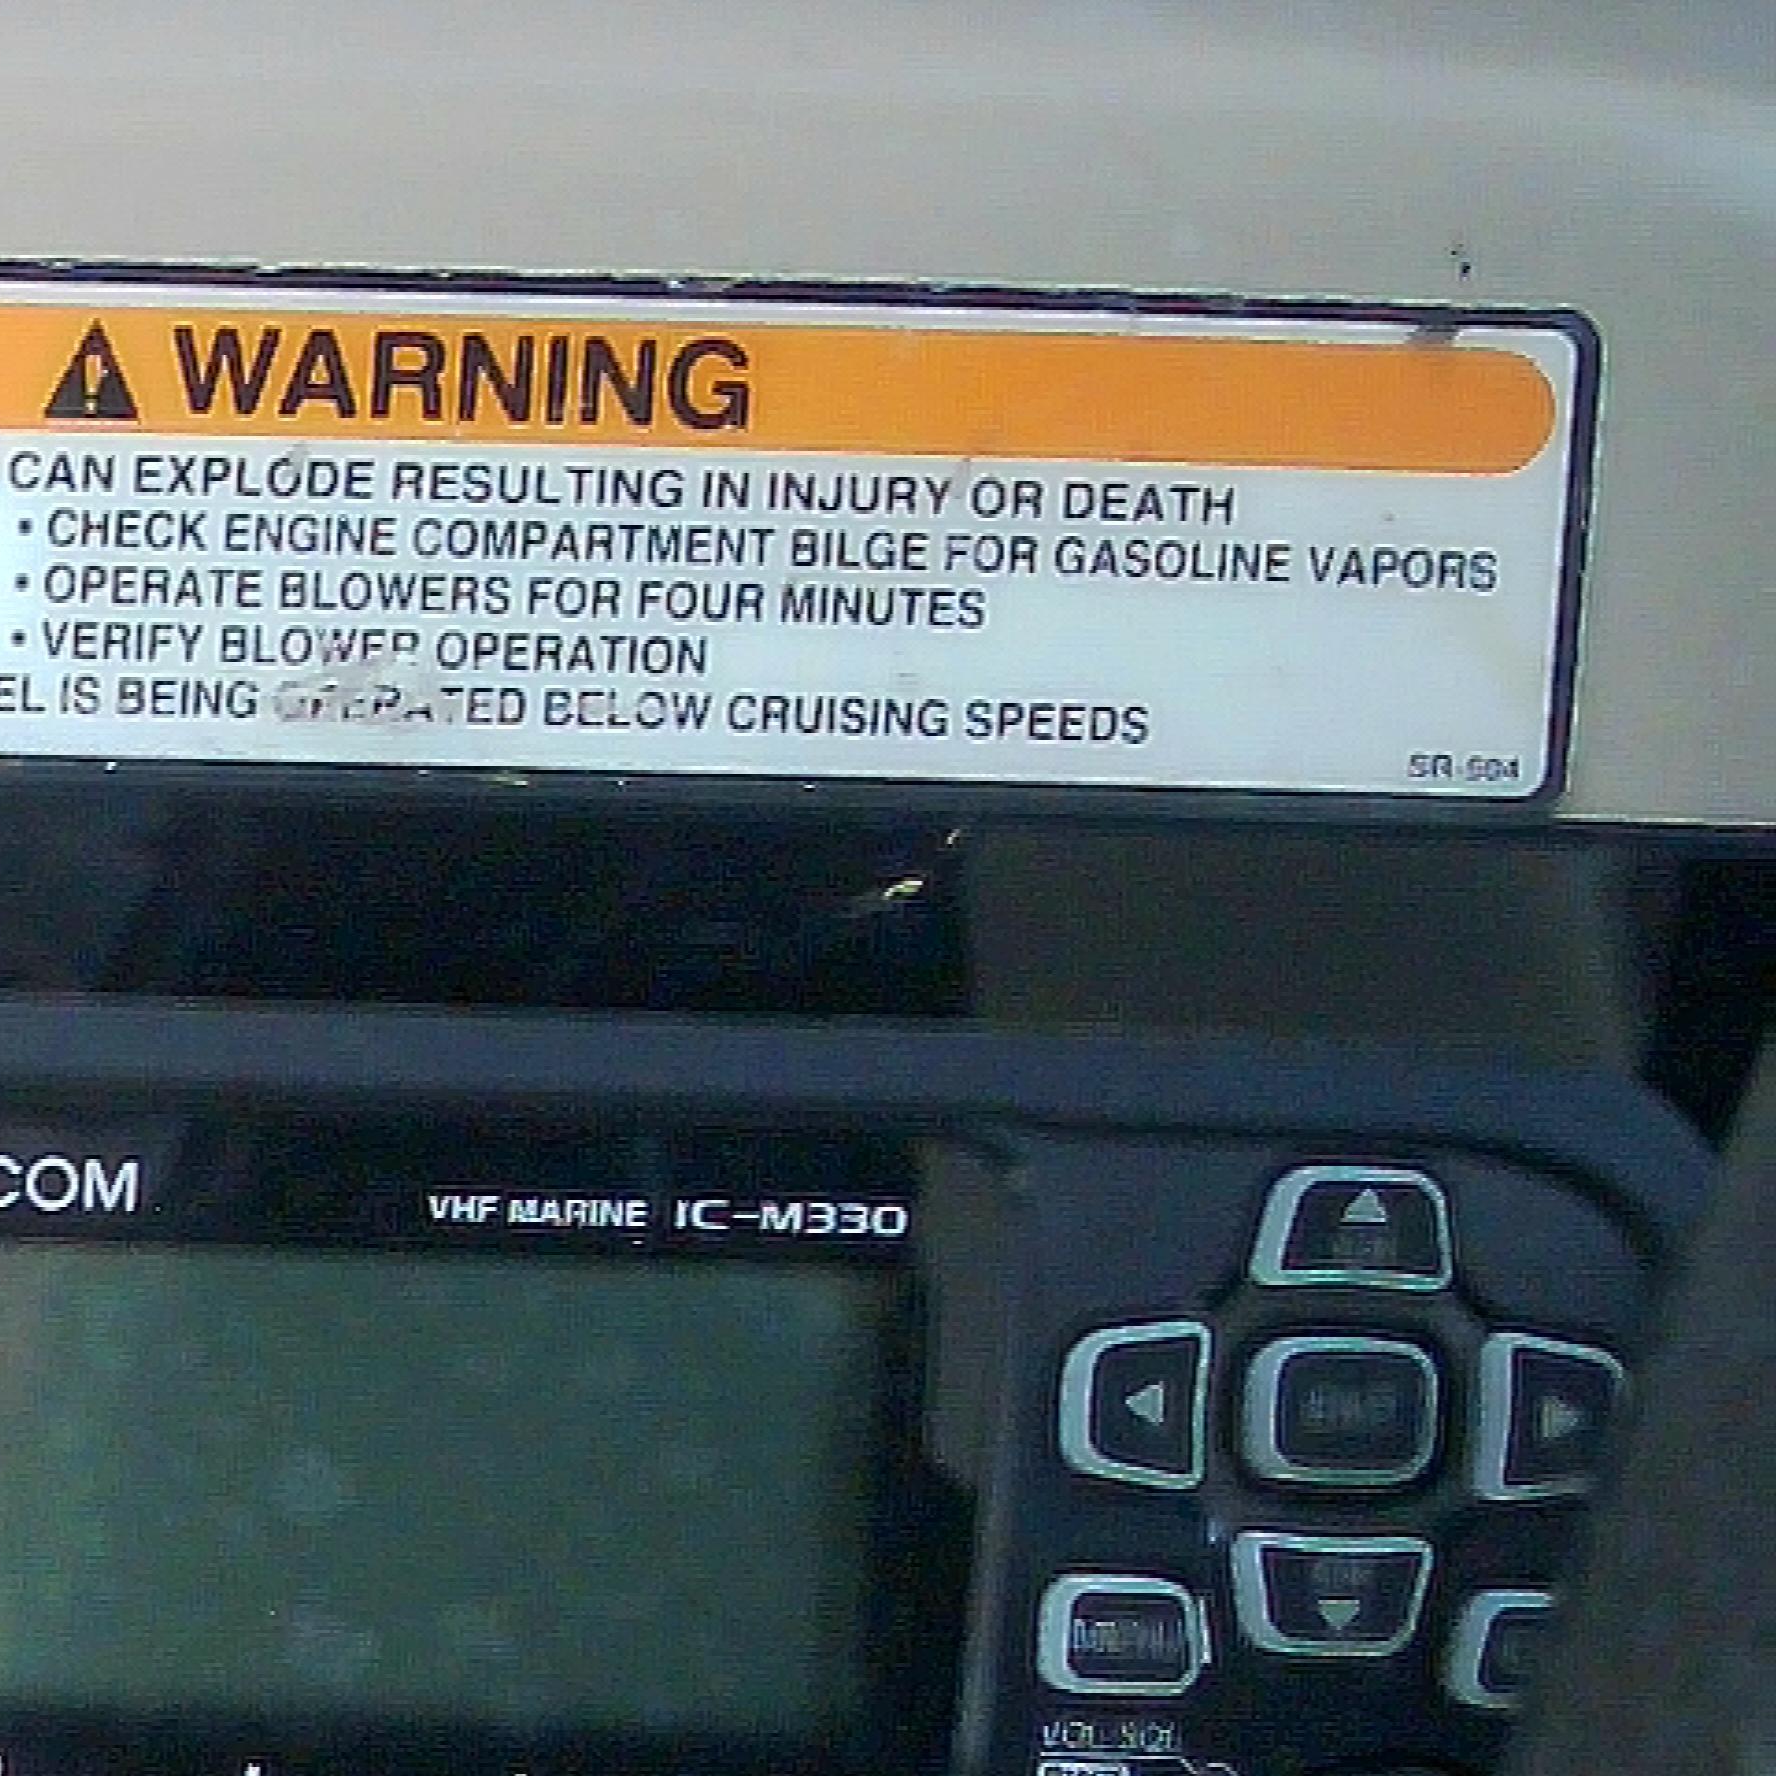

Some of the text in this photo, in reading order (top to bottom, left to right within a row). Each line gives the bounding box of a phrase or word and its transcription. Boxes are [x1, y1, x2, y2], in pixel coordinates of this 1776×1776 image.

[173, 325, 748, 430] WARNING
[10, 452, 114, 494] CAN
[133, 457, 374, 499] EXPLODE
[393, 463, 684, 508] RESULTING
[703, 471, 749, 509] IN
[768, 472, 951, 517] INJURY
[970, 478, 1045, 520] OR
[1064, 483, 1235, 524] DEATH
[48, 511, 1498, 592] CHECK ENGINE COMPARTMENT BILGE FOR GASOLINE VAPORS
[45, 567, 984, 628] OPERATE BLOWERS FOR FOUR MINUTES
[43, 623, 202, 664] VERIFY
[221, 625, 418, 666] BLOWER
[436, 632, 707, 674] OPERATION
[61, 677, 100, 714] IS
[119, 679, 257, 719] BEING
[544, 690, 710, 730] BELOW
[728, 696, 950, 738] CRUISING
[965, 701, 1149, 744] SPEEDS
[428, 1196, 908, 1235] VHF MARINE IC-M330
